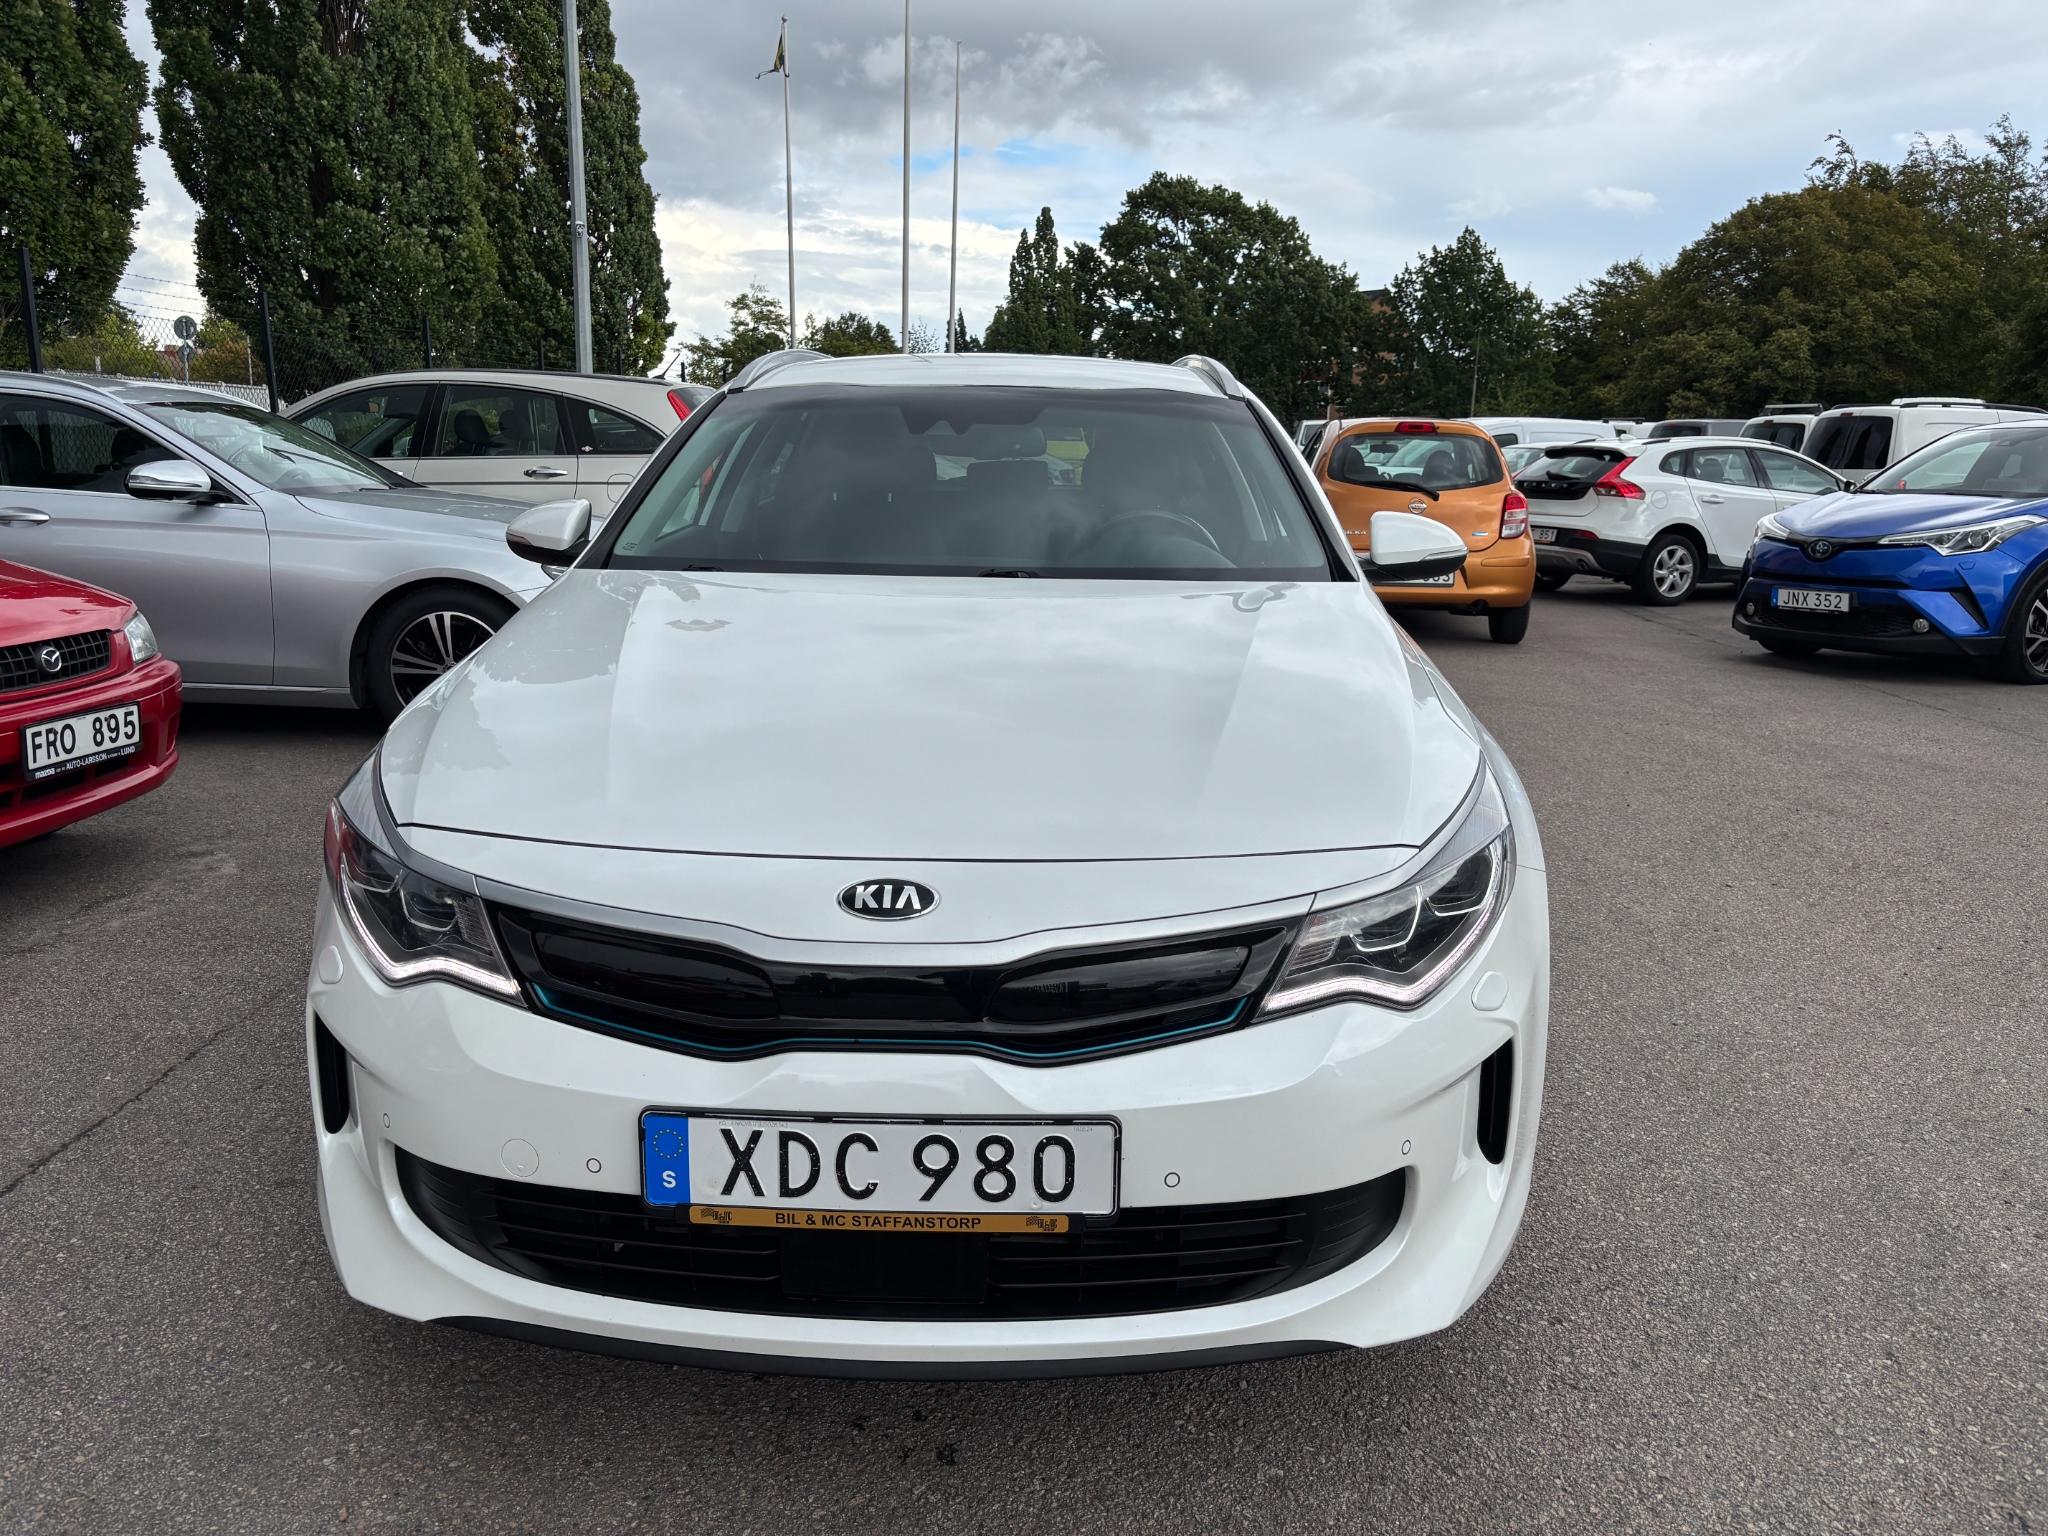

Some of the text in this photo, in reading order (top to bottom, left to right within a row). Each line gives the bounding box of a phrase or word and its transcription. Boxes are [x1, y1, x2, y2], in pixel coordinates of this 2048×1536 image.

[1539, 529, 1555, 541] 851
[1783, 591, 1842, 609] JNX 352
[31, 710, 136, 764] FRO 895
[66, 752, 107, 769] AUTO-LARSSON
[120, 745, 136, 756] LUND
[854, 884, 922, 910] KIA
[720, 1128, 1075, 1203] XDC 980
[662, 1170, 677, 1188] S
[775, 1213, 981, 1230] BIL & MC STAFFANSTORP
